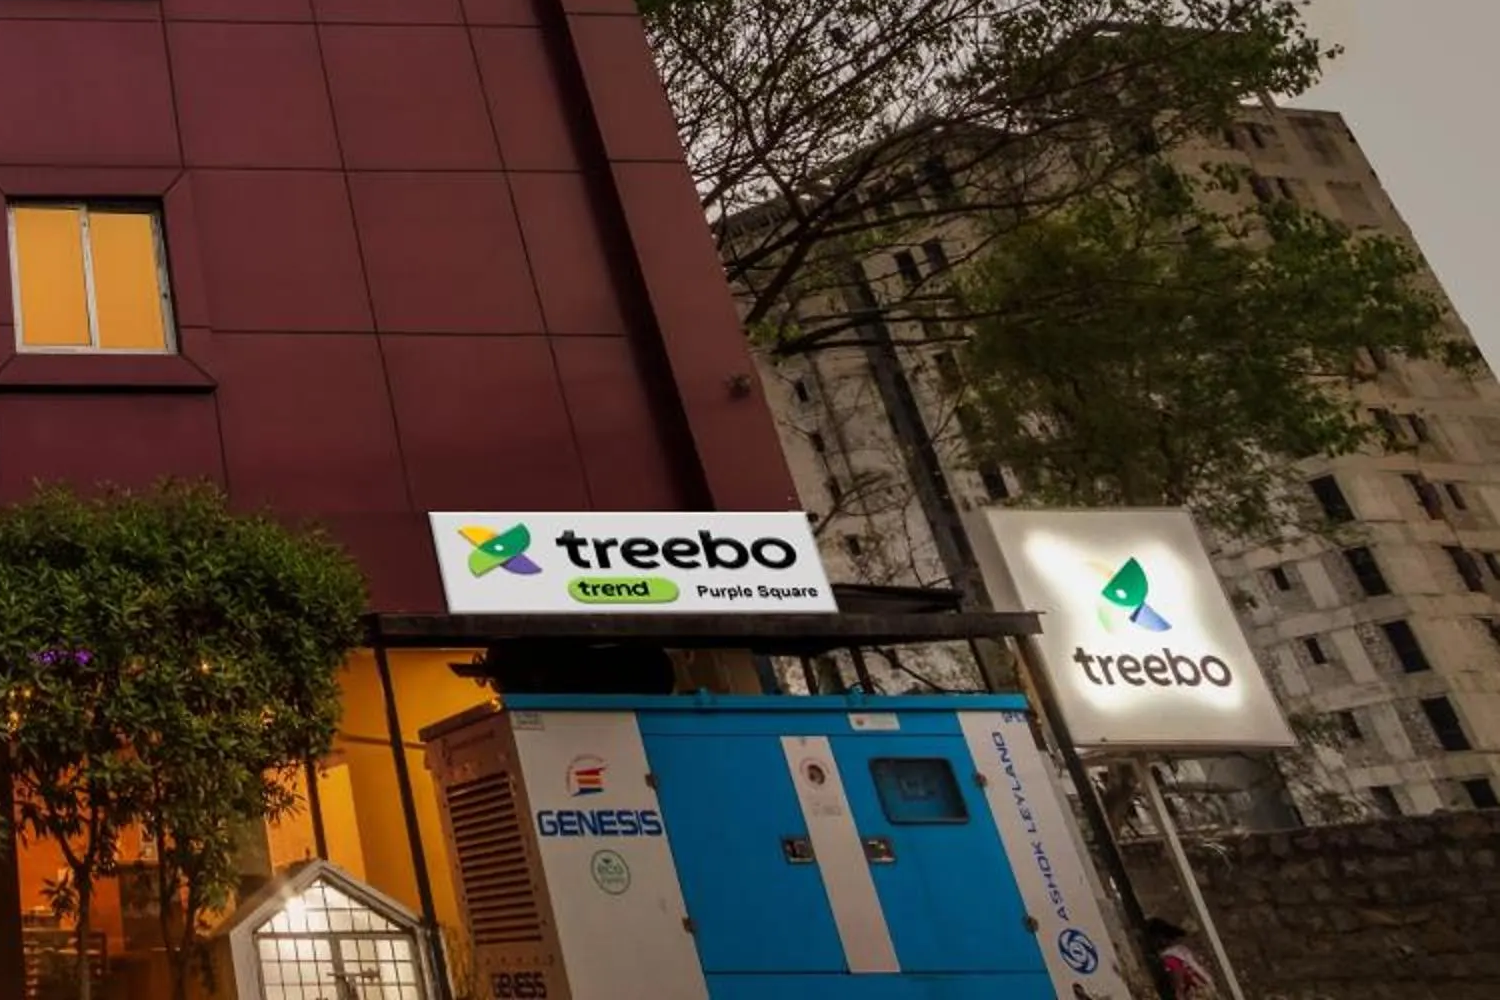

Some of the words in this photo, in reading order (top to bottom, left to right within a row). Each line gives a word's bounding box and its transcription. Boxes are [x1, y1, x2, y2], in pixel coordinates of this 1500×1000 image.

[555, 529, 797, 570] treebo
[578, 580, 650, 597] trend
[697, 584, 753, 601] Purple
[757, 584, 819, 601] Square
[1073, 646, 1232, 688] treebo
[991, 731, 1037, 834] LEYLAND
[536, 809, 663, 837] GENESIS
[1030, 841, 1070, 921] ASHOK
